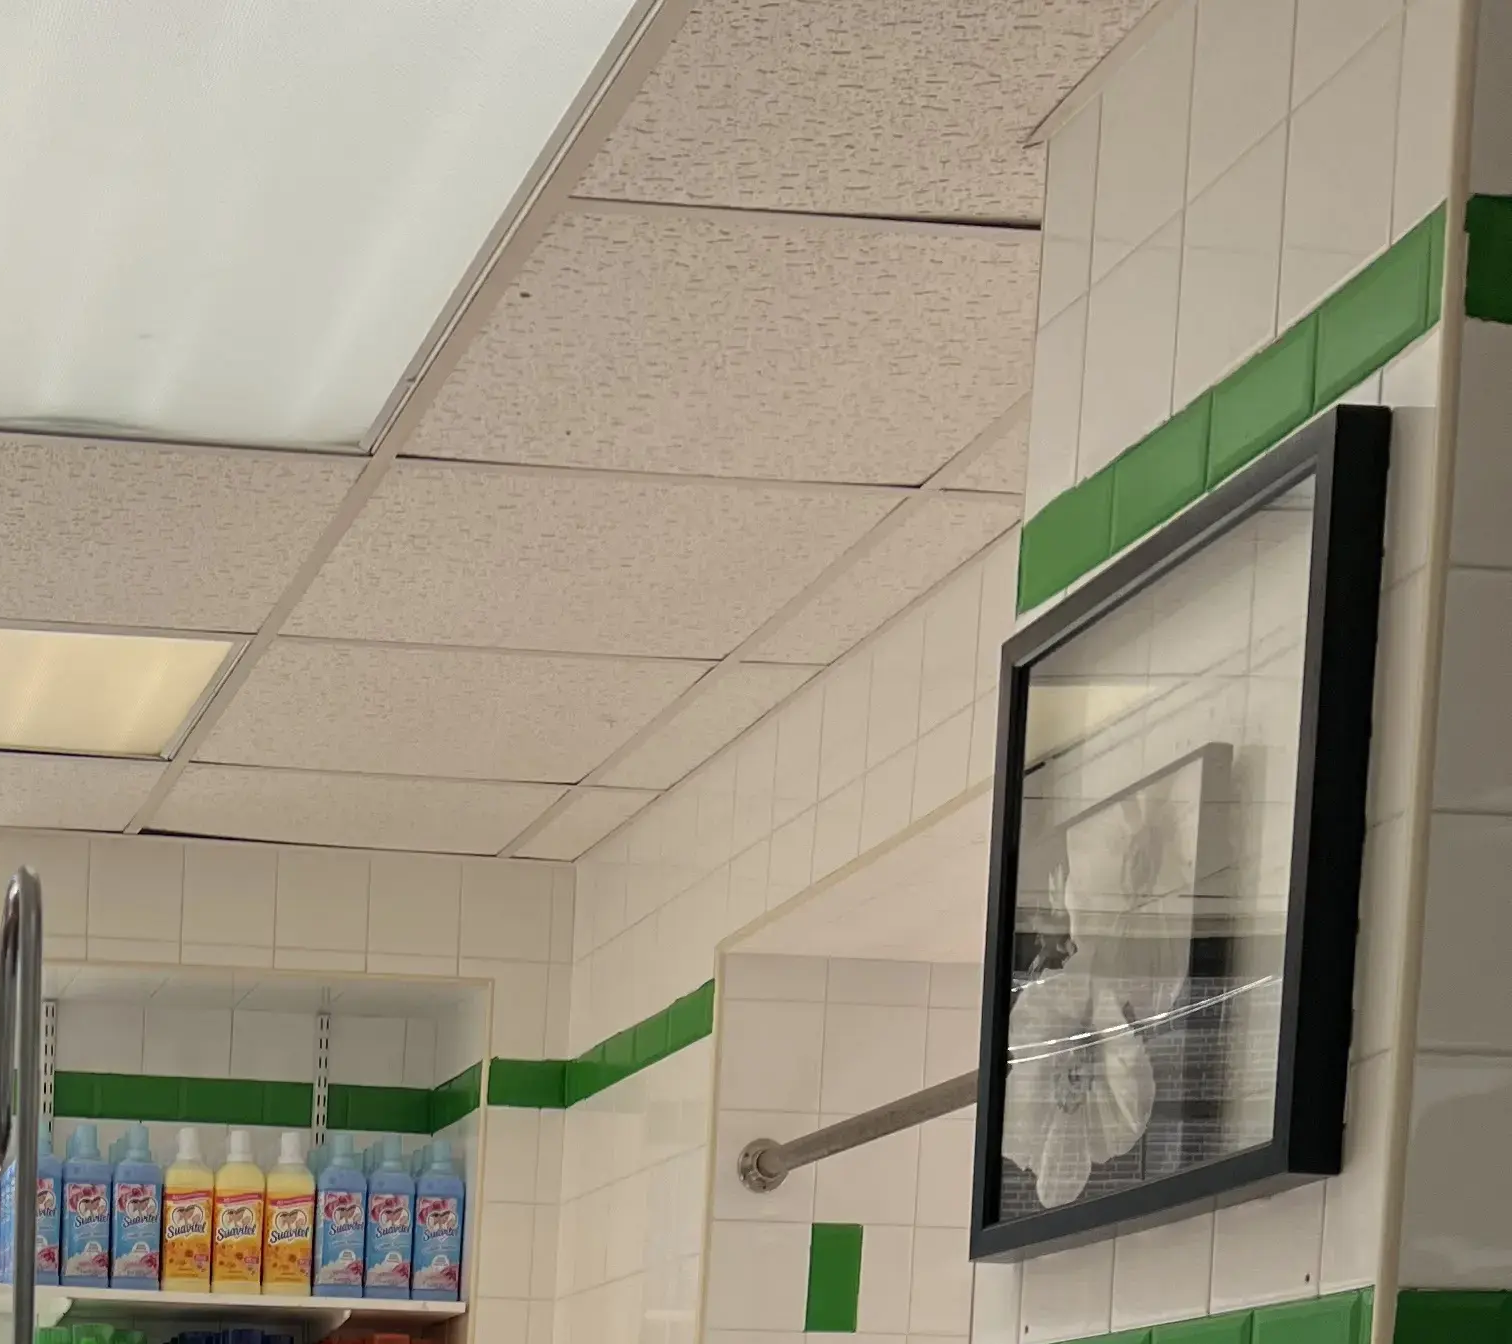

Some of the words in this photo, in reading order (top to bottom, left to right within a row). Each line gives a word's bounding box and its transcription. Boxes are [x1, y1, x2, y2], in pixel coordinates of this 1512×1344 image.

[122, 1214, 159, 1228] Suavitel
[329, 1221, 364, 1236] Suavitel
[166, 1222, 206, 1238] Suavitel
[217, 1224, 256, 1241] Suavitel
[270, 1226, 309, 1244] Suavitel
[375, 1224, 411, 1238] Suavitel
